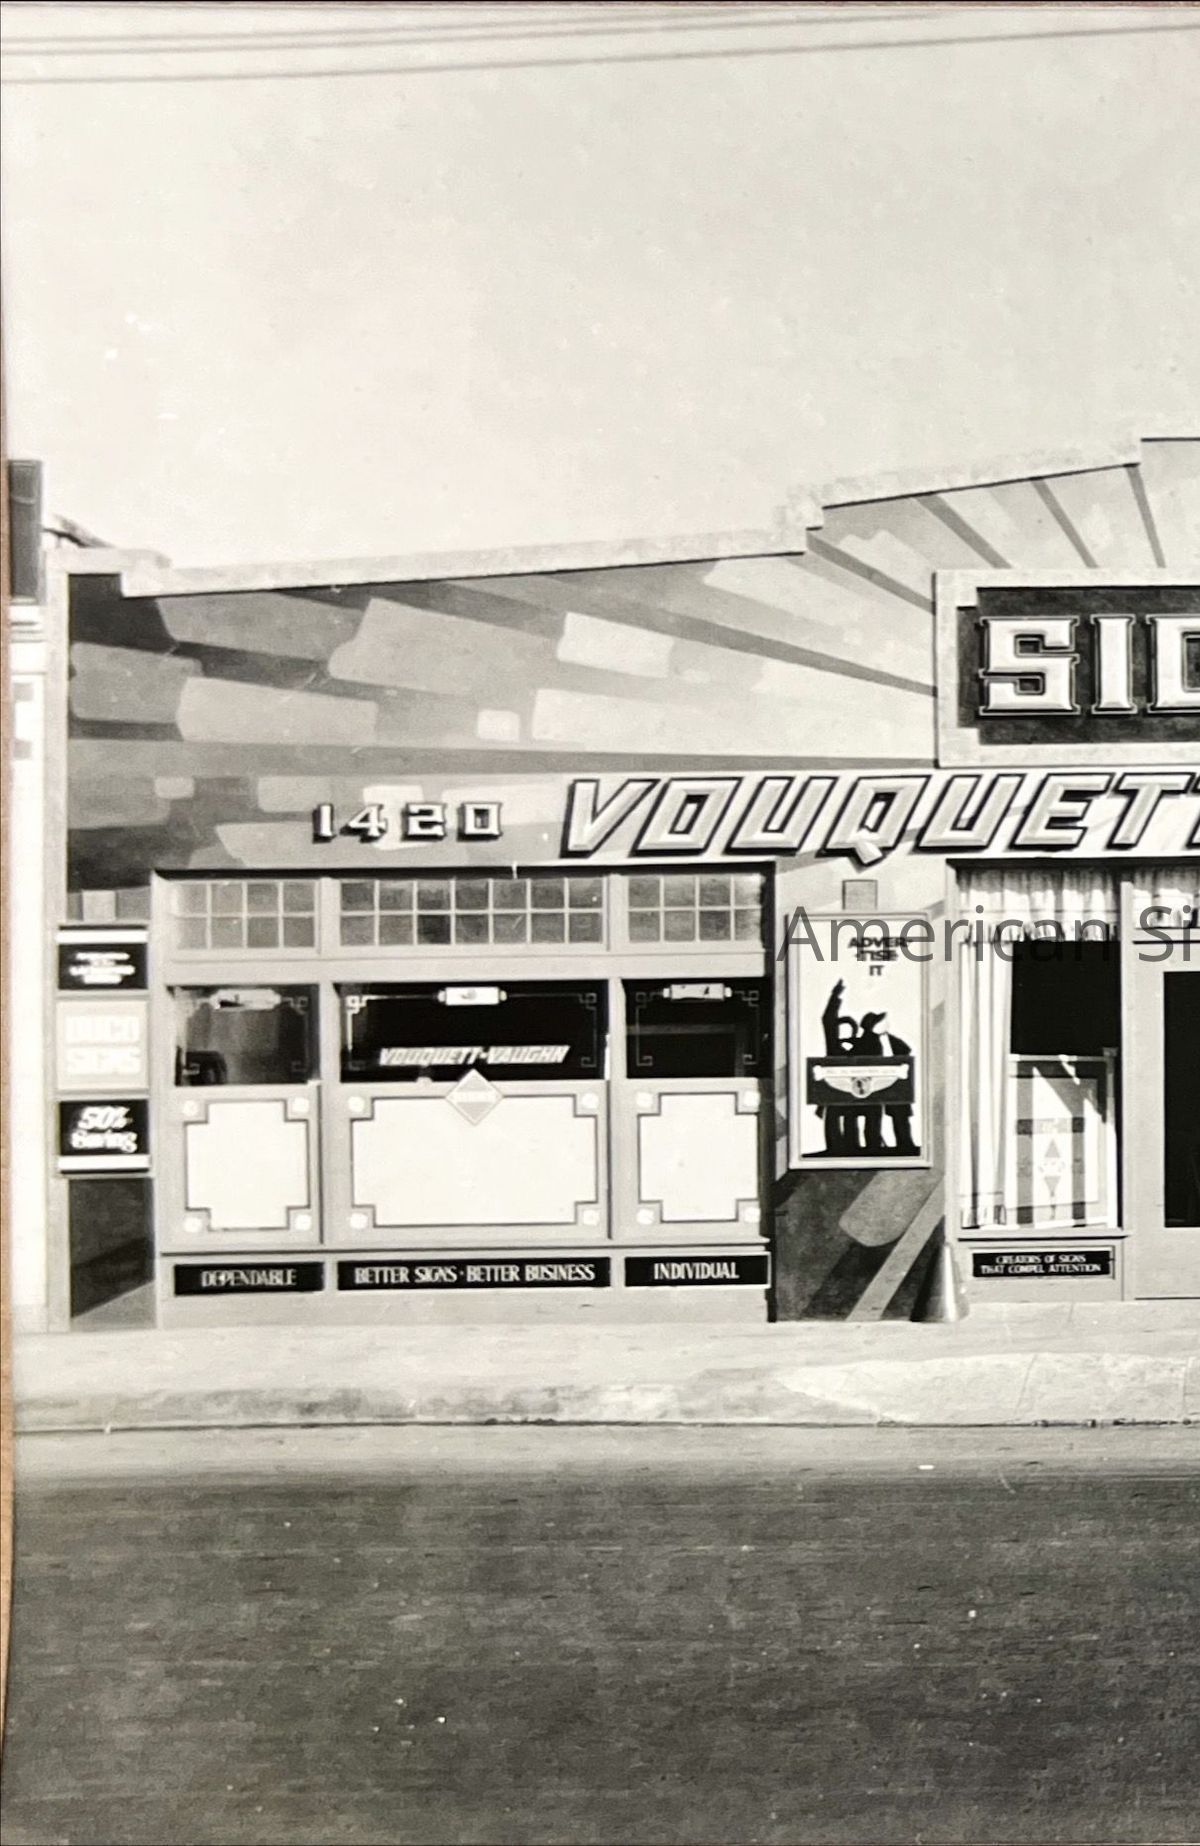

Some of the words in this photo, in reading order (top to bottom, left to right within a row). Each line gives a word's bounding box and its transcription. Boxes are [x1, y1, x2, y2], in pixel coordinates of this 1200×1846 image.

[313, 802, 503, 843] 1420
[869, 965, 884, 976] IT
[995, 1255, 1041, 1264] CREATORS
[1044, 1254, 1056, 1263] OF
[1058, 1254, 1087, 1263] SIGNS
[354, 1266, 409, 1284] BETTER
[466, 1265, 520, 1283] BETTER
[525, 1263, 596, 1282] BUSINESS
[653, 1262, 741, 1280] INDIVIDUAL
[981, 1265, 1004, 1274] THAT
[1008, 1264, 1045, 1274] COMPEL
[1049, 1263, 1101, 1273] ATTENTION
[201, 1269, 298, 1287] DEPENDABLE
